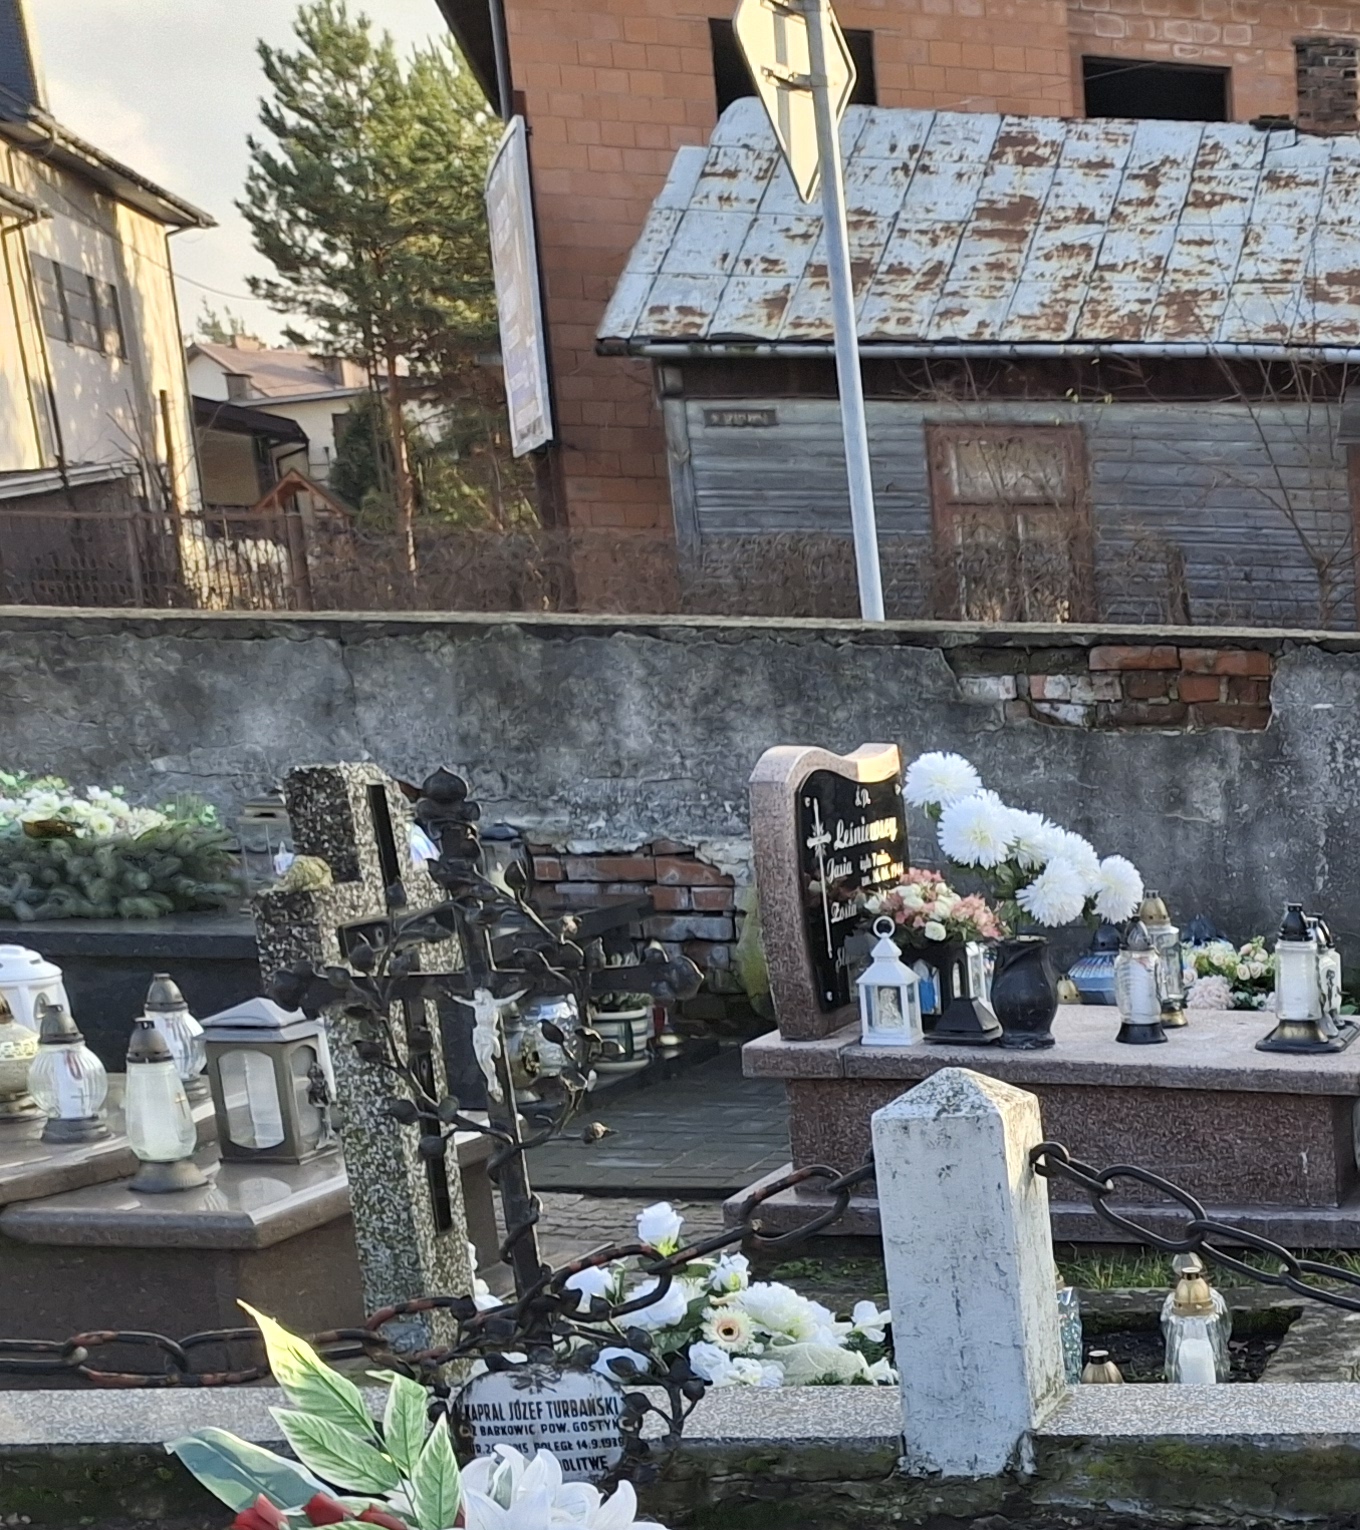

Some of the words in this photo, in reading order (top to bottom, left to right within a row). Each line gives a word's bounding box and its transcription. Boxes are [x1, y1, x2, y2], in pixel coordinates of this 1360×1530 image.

[509, 1400, 543, 1421] JÓZEF
[545, 1394, 619, 1420] TURBAŃSKI
[541, 1423, 570, 1434] POW.
